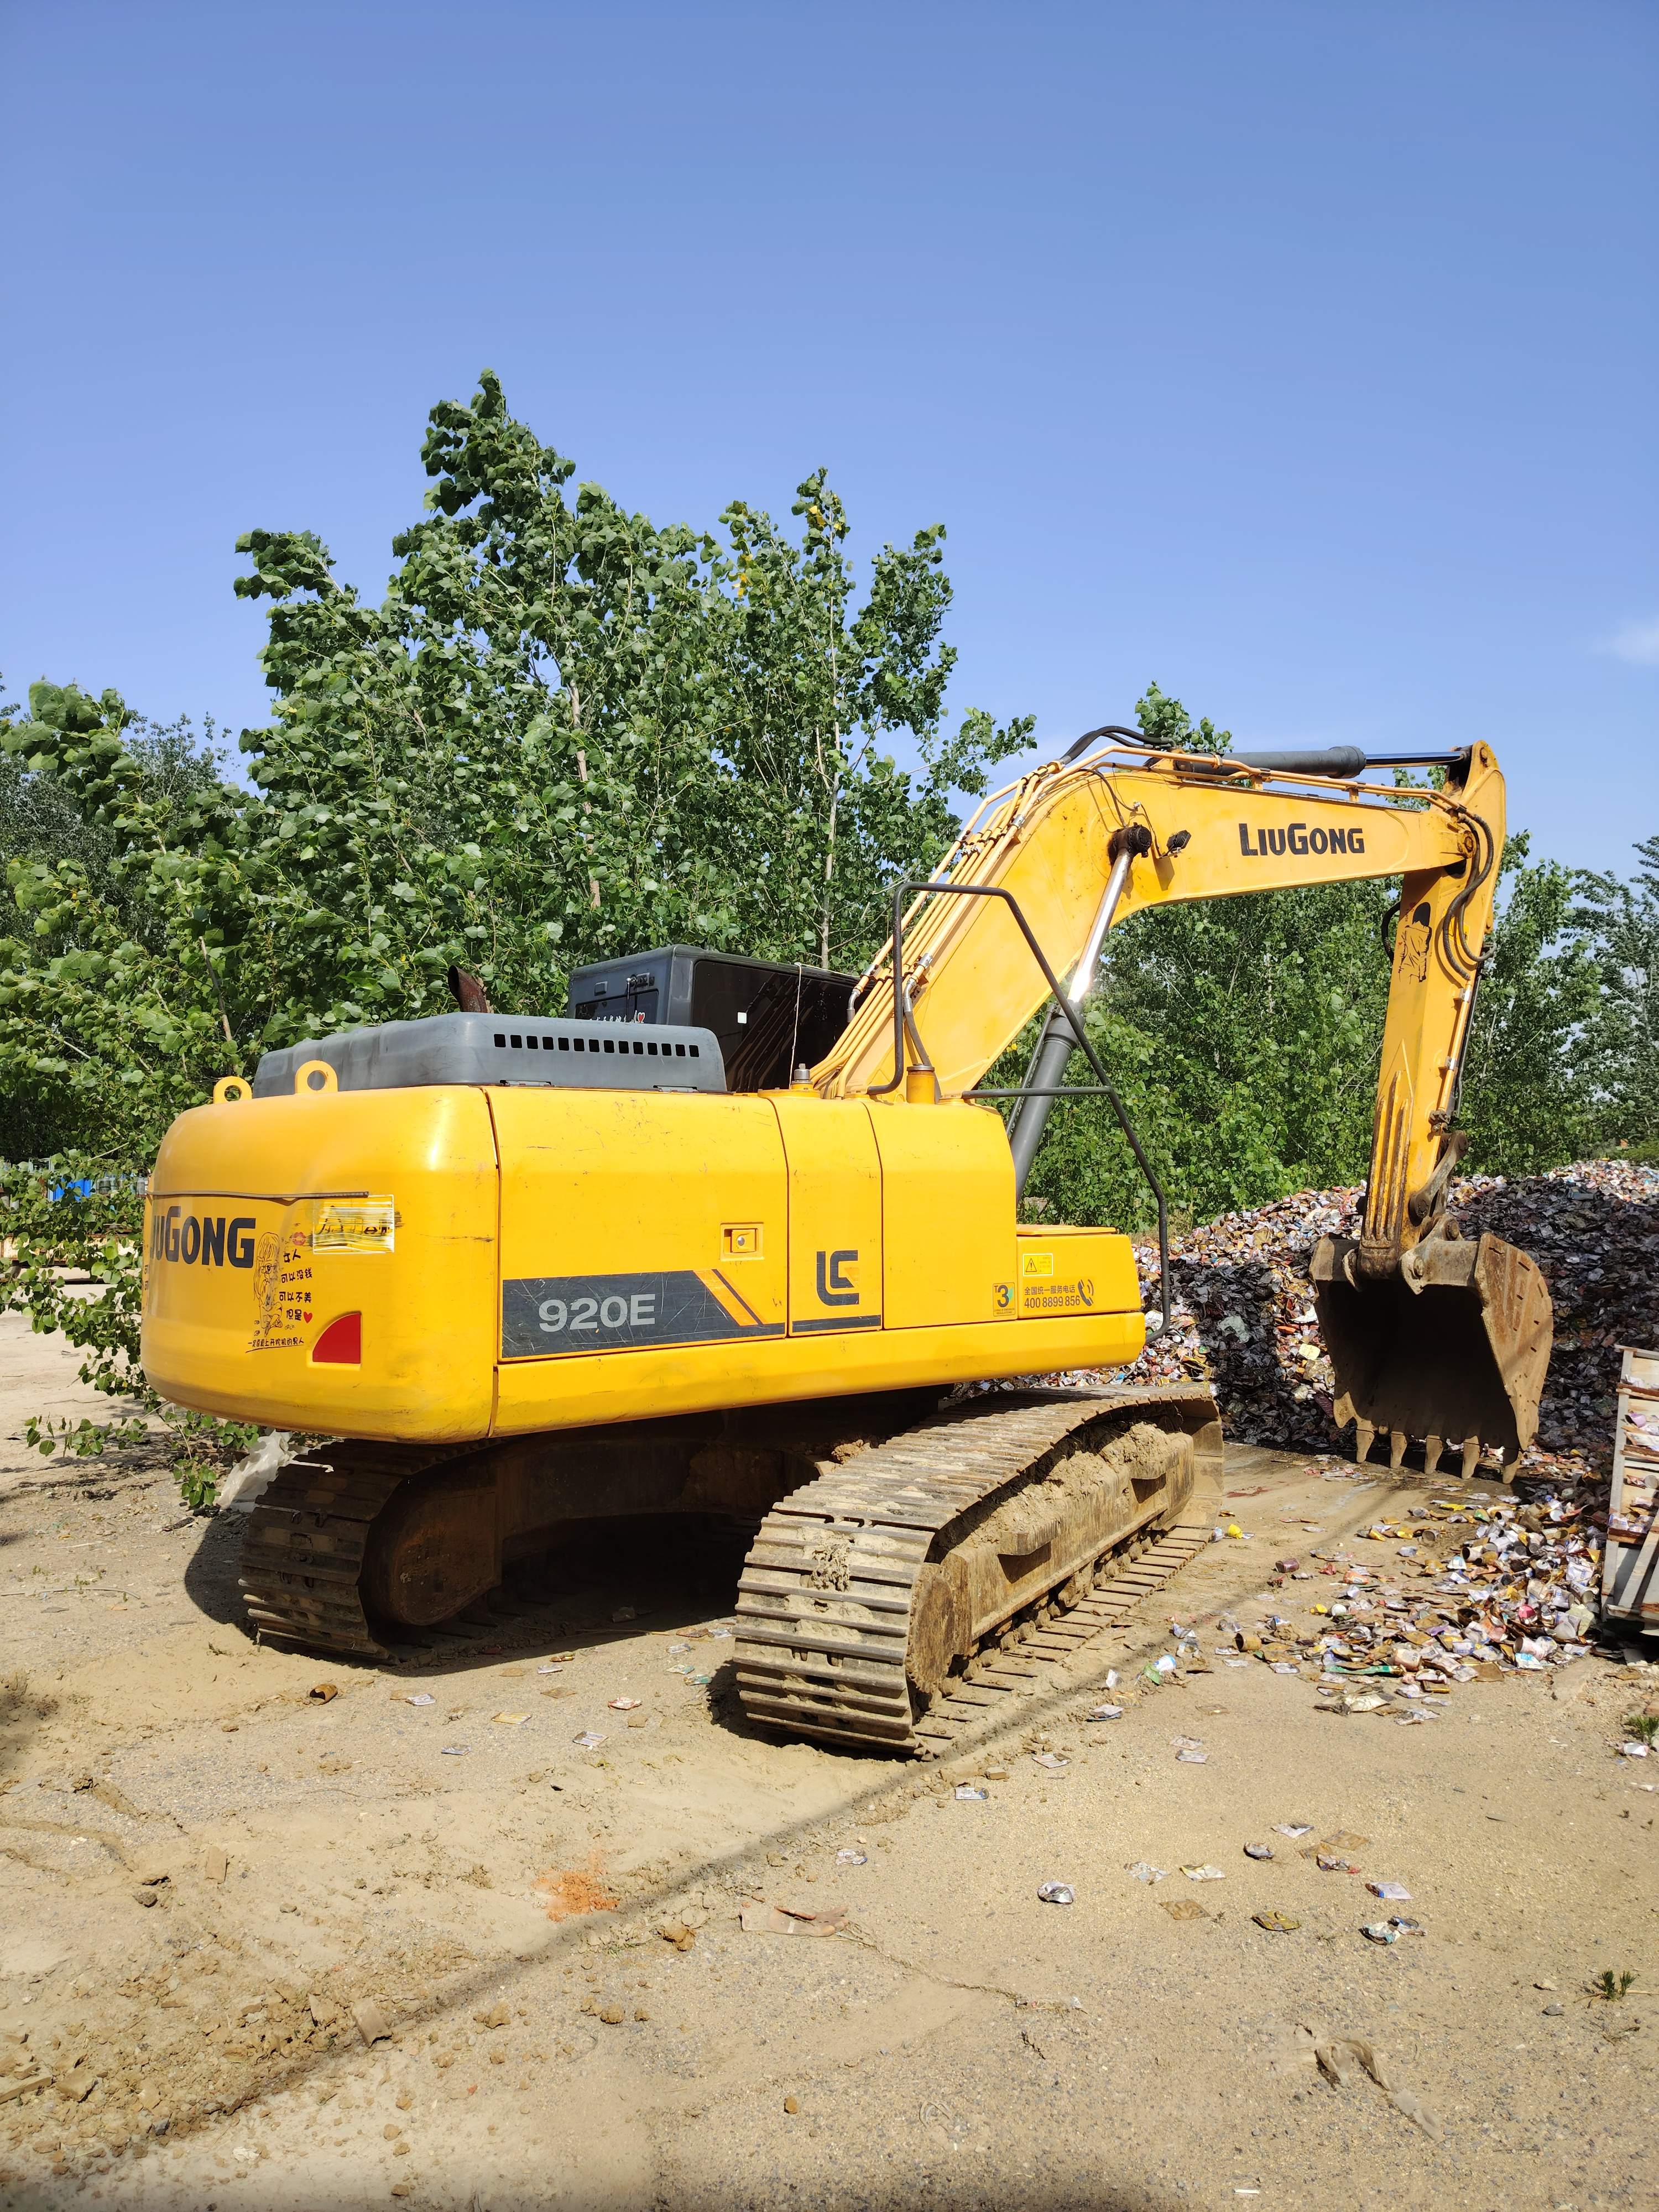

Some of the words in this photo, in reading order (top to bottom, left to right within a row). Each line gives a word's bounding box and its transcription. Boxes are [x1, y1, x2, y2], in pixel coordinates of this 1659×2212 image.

[283, 1248, 301, 1263] 女人
[281, 1267, 312, 1284] 可以没钱
[1024, 1285, 1076, 1295] 全国统一服务电话
[279, 1291, 312, 1303] 可以不美
[1024, 1297, 1041, 1308] 400
[1042, 1296, 1063, 1308] 8899
[1065, 1295, 1081, 1306] 856
[286, 1308, 302, 1321] 但是
[538, 1293, 656, 1332] 920E
